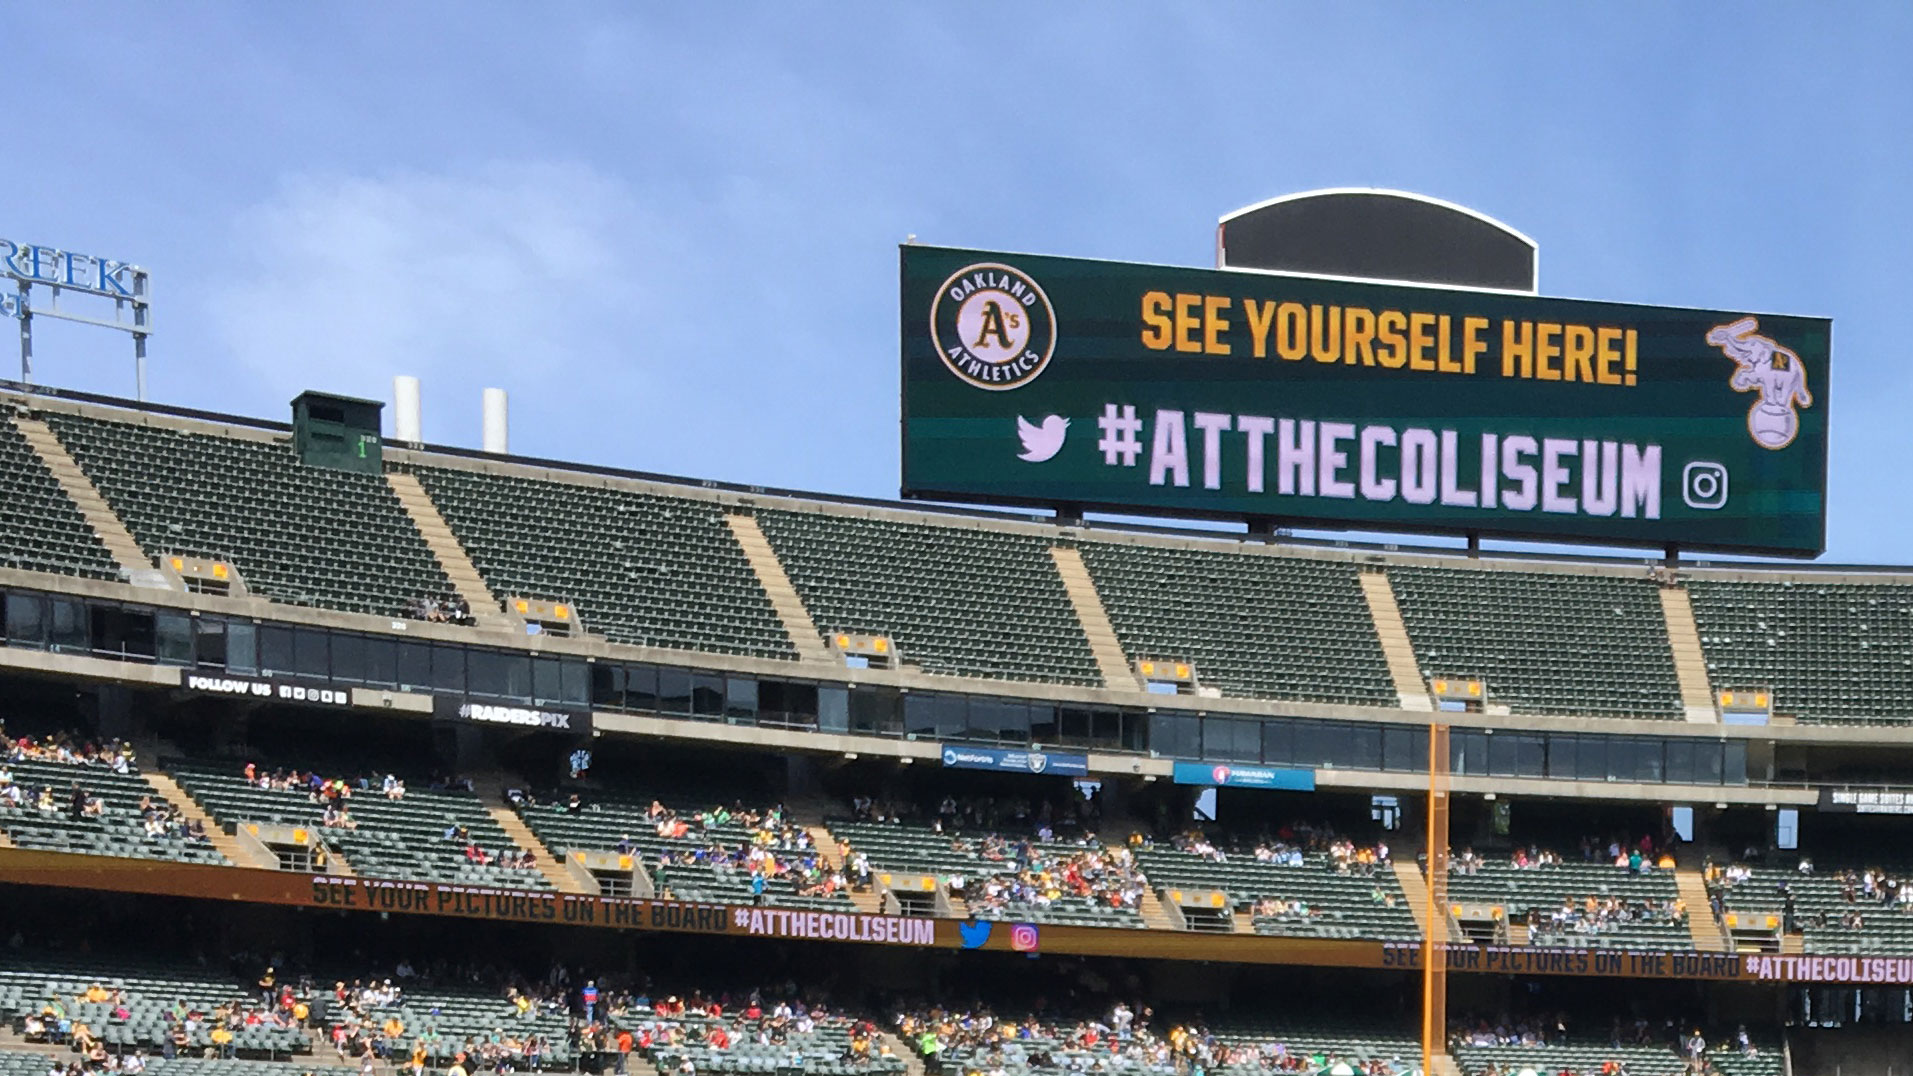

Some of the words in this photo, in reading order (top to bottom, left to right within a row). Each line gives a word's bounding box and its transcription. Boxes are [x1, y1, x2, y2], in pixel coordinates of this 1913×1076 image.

[950, 272, 1037, 307] OAKLAND
[1141, 290, 1232, 355] SEE
[1243, 298, 1490, 375] YOURSELF
[1501, 319, 1638, 387] HERE!
[948, 345, 1040, 382] ATHLETICS
[1097, 402, 1662, 520] #ATTHECOLISEUM
[189, 676, 249, 694] FOLLOW
[251, 683, 272, 696] US
[458, 703, 570, 729] #RAIDERSPIX
[313, 876, 357, 906] SEE
[363, 880, 429, 911] YOUR
[437, 885, 556, 919] PICTURES
[564, 894, 595, 922] ON
[600, 898, 644, 926] THE
[651, 901, 728, 930] BOARD
[734, 907, 935, 944] #ATTHECOLISEUM
[1383, 942, 1421, 967] SEE
[1486, 946, 1589, 971] PICTURES
[1596, 949, 1623, 973] ON
[1628, 950, 1667, 975] THE
[1672, 952, 1740, 977] BOARD
[1745, 955, 1913, 982] #ATTHECOLISEU
